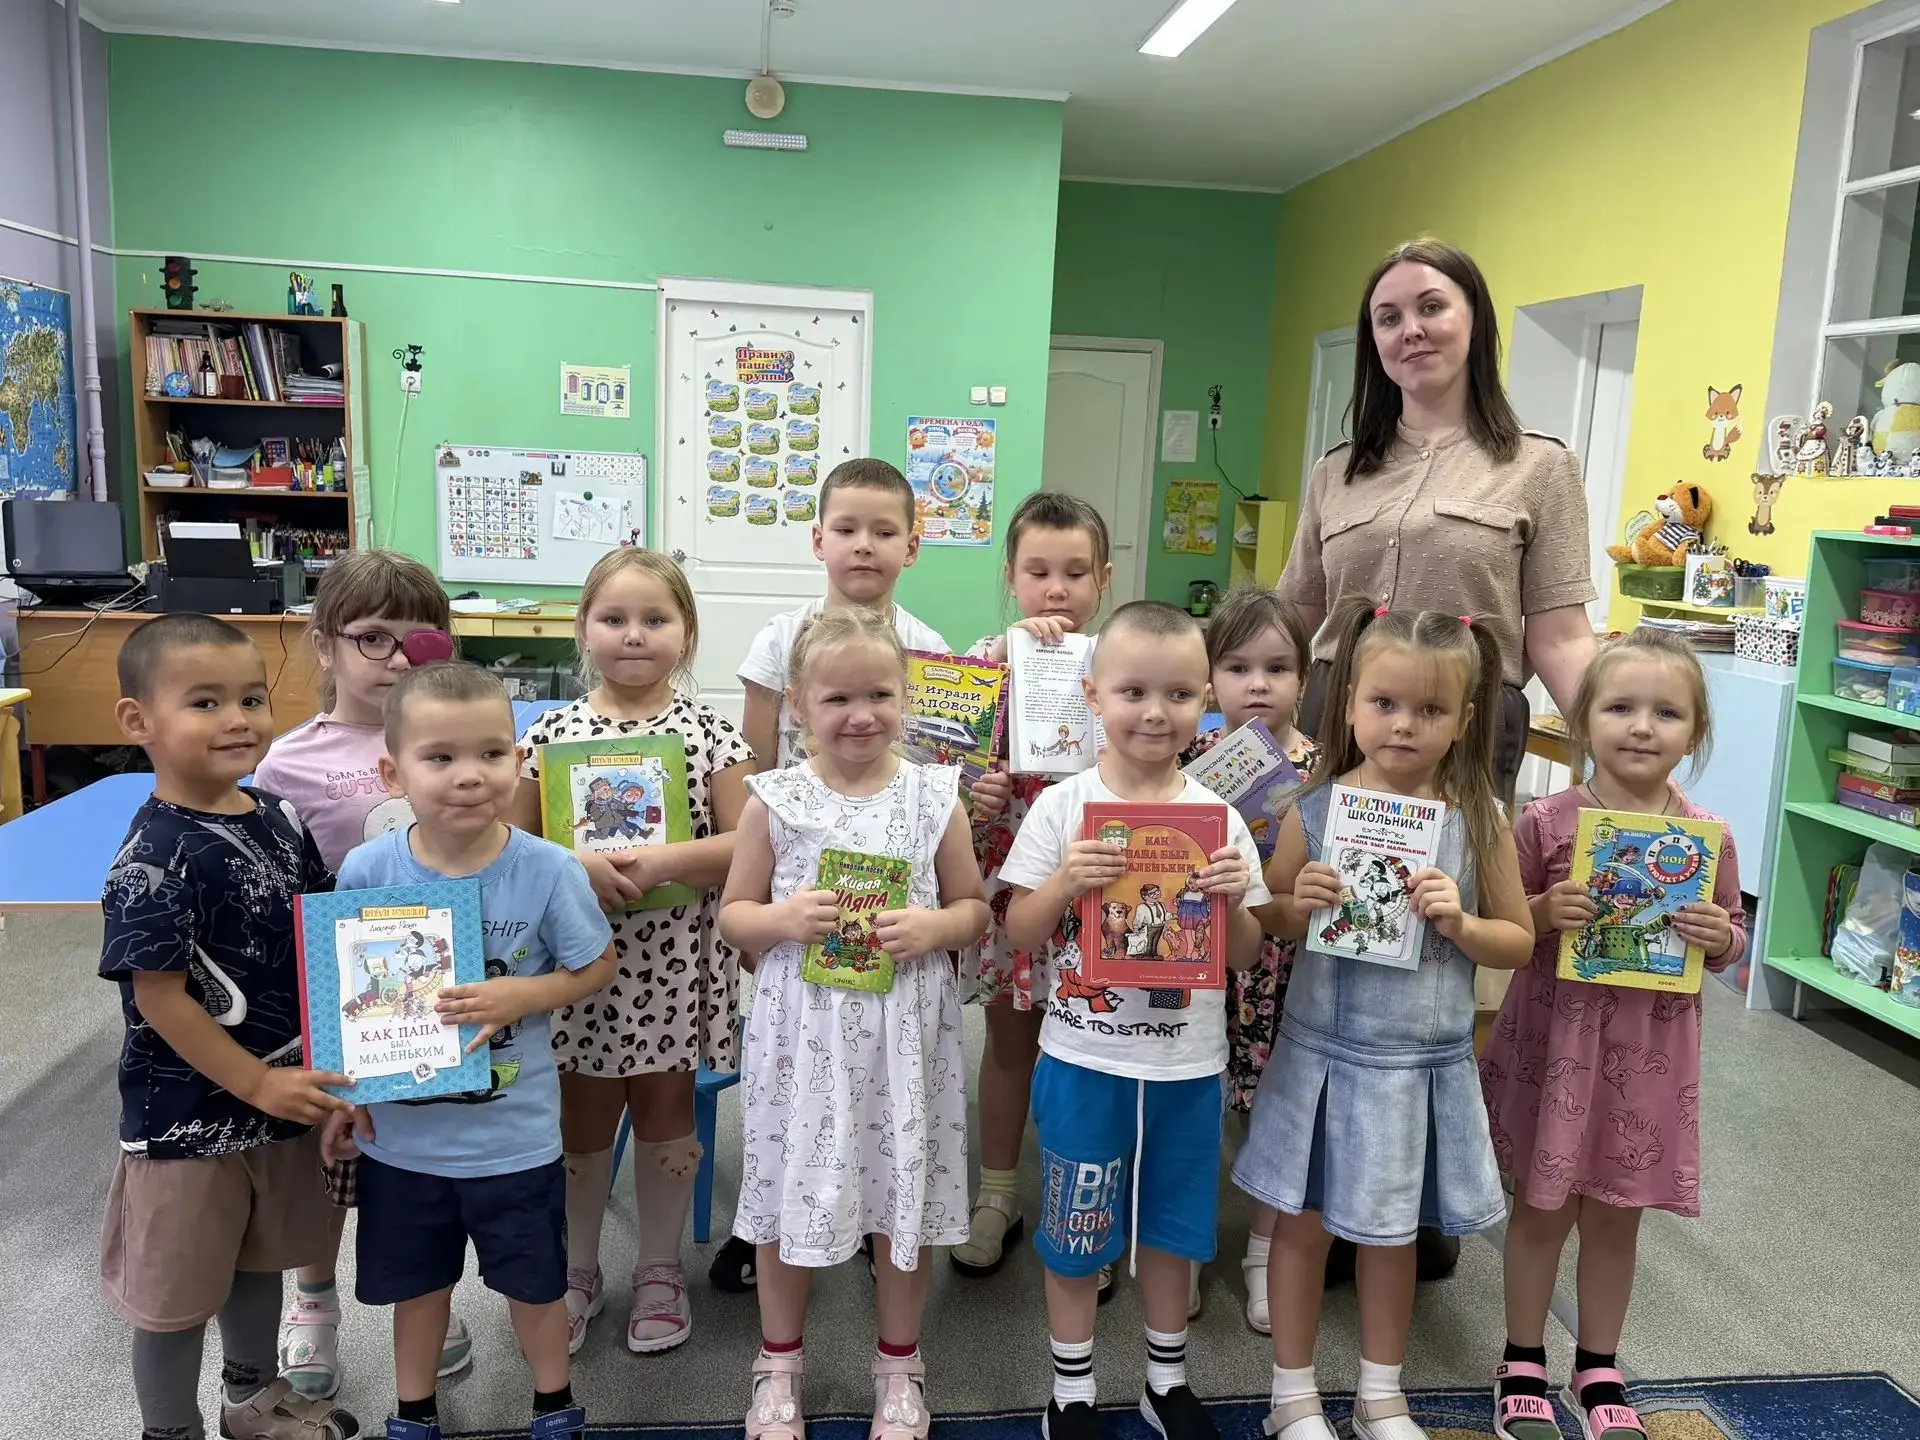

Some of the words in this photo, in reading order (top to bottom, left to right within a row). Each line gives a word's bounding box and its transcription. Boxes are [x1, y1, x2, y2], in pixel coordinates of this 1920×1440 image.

[738, 349, 793, 360] Правила
[738, 373, 789, 382] группы
[919, 417, 959, 426] ВРЕМЕНА
[961, 419, 984, 427] ГОДА
[907, 683, 920, 692] ы
[1196, 752, 1225, 778] Александр
[1225, 738, 1245, 758] Раскин
[1212, 773, 1235, 794] ИСАЛ
[1219, 759, 1266, 800] ОЧИНЕНИЯ
[1339, 792, 1437, 821] ХРЕСТОМАТИЯ
[1347, 809, 1424, 832] ШКОЛЬНИКА
[1144, 836, 1170, 846] КАК
[1336, 835, 1349, 843] КАК
[1350, 838, 1368, 846] ПАПА
[1386, 844, 1427, 856] МАЛЕНЬКИМ
[1355, 834, 1386, 842] АЛЕКСАНДР
[1125, 849, 1158, 859] ПАПА
[1160, 850, 1190, 860] БЫЛ
[839, 861, 864, 872] Николай
[865, 864, 884, 875] Носов
[1125, 862, 1196, 873] АЛЕНЬКИМ
[1647, 854, 1700, 883] МЮНХГАУЗЕН
[834, 874, 882, 892] Живая
[1049, 1001, 1086, 1030] DARE
[1087, 1019, 1115, 1036] TO
[1117, 1022, 1189, 1039] START
[360, 1028, 393, 1042] КАК
[398, 1023, 441, 1039] ПАПА
[391, 1039, 413, 1049] БЫЛ
[359, 1045, 445, 1065] МАЛЕНЬКИМ
[1047, 1166, 1063, 1235] SUPERIOR
[545, 1416, 568, 1428] reima
